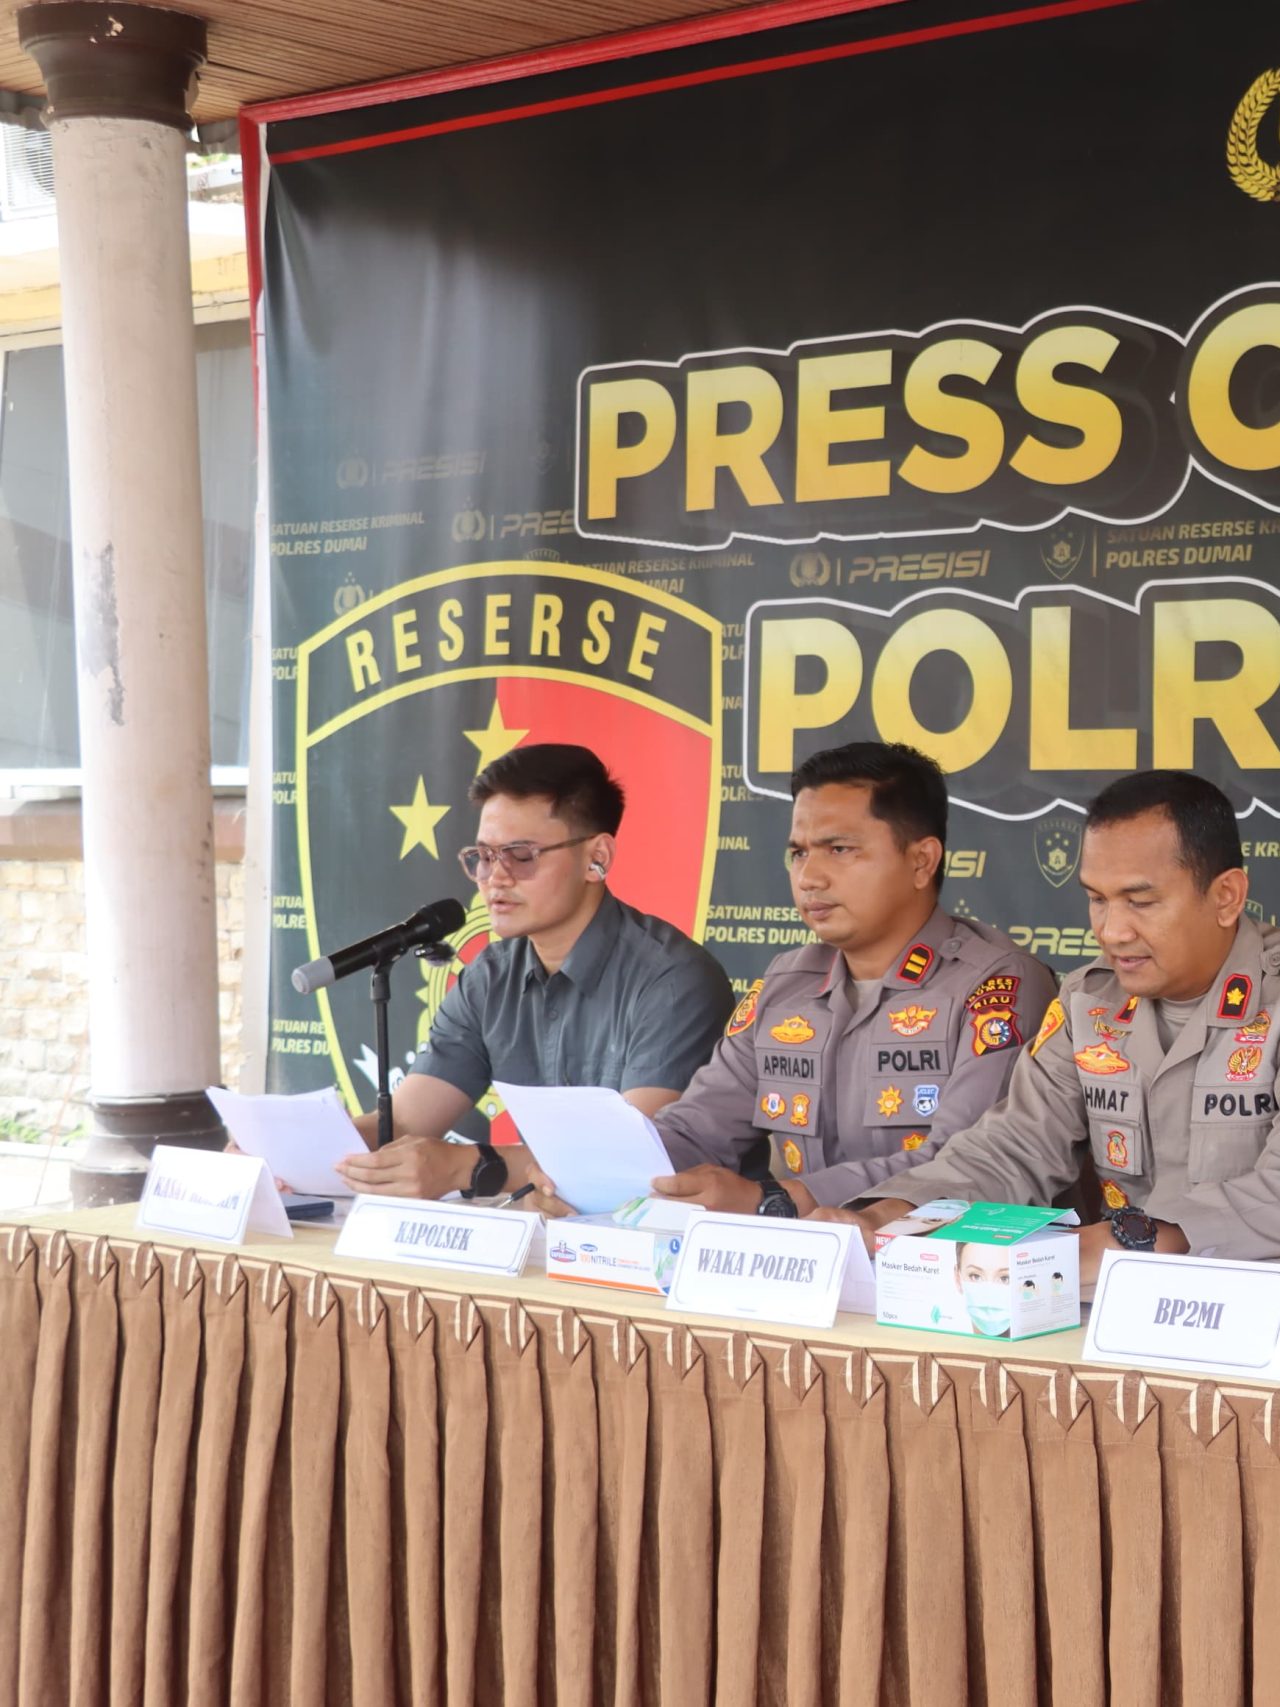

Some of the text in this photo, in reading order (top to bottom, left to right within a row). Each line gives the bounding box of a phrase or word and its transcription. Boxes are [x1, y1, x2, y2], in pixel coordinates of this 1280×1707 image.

[587, 325, 1123, 520] PRESS
[382, 451, 487, 482] PRESISI
[320, 517, 368, 533] RESERSE
[371, 511, 425, 529] KRIMINAL
[499, 509, 576, 539] PRES
[1107, 525, 1175, 544] SATUAN
[1178, 520, 1255, 539] RESERSE
[324, 536, 368, 553] DUMAI
[1105, 544, 1253, 569] POLRES DUMAI
[628, 557, 686, 575] RESERSE
[689, 553, 755, 570] KRIMINAL
[849, 549, 992, 584] PRESISI
[642, 577, 685, 593] UMAI
[345, 593, 668, 693] RESERSE
[706, 905, 799, 921] SATUAN RESE
[705, 926, 823, 945] POLRES DUMA
[1008, 926, 1104, 956] PRES
[973, 996, 1010, 1010] RIAU
[763, 1055, 814, 1079] APRIADI
[878, 1050, 940, 1072] POLRI
[1084, 1086, 1129, 1113] HMAT
[394, 1221, 474, 1251] KAPOLSEK
[591, 1255, 617, 1267] NITRILE
[698, 1247, 817, 1284] WAKA POLRES
[881, 1261, 940, 1275] Masker Bedah Karet
[1153, 1297, 1225, 1331] BP2MI
